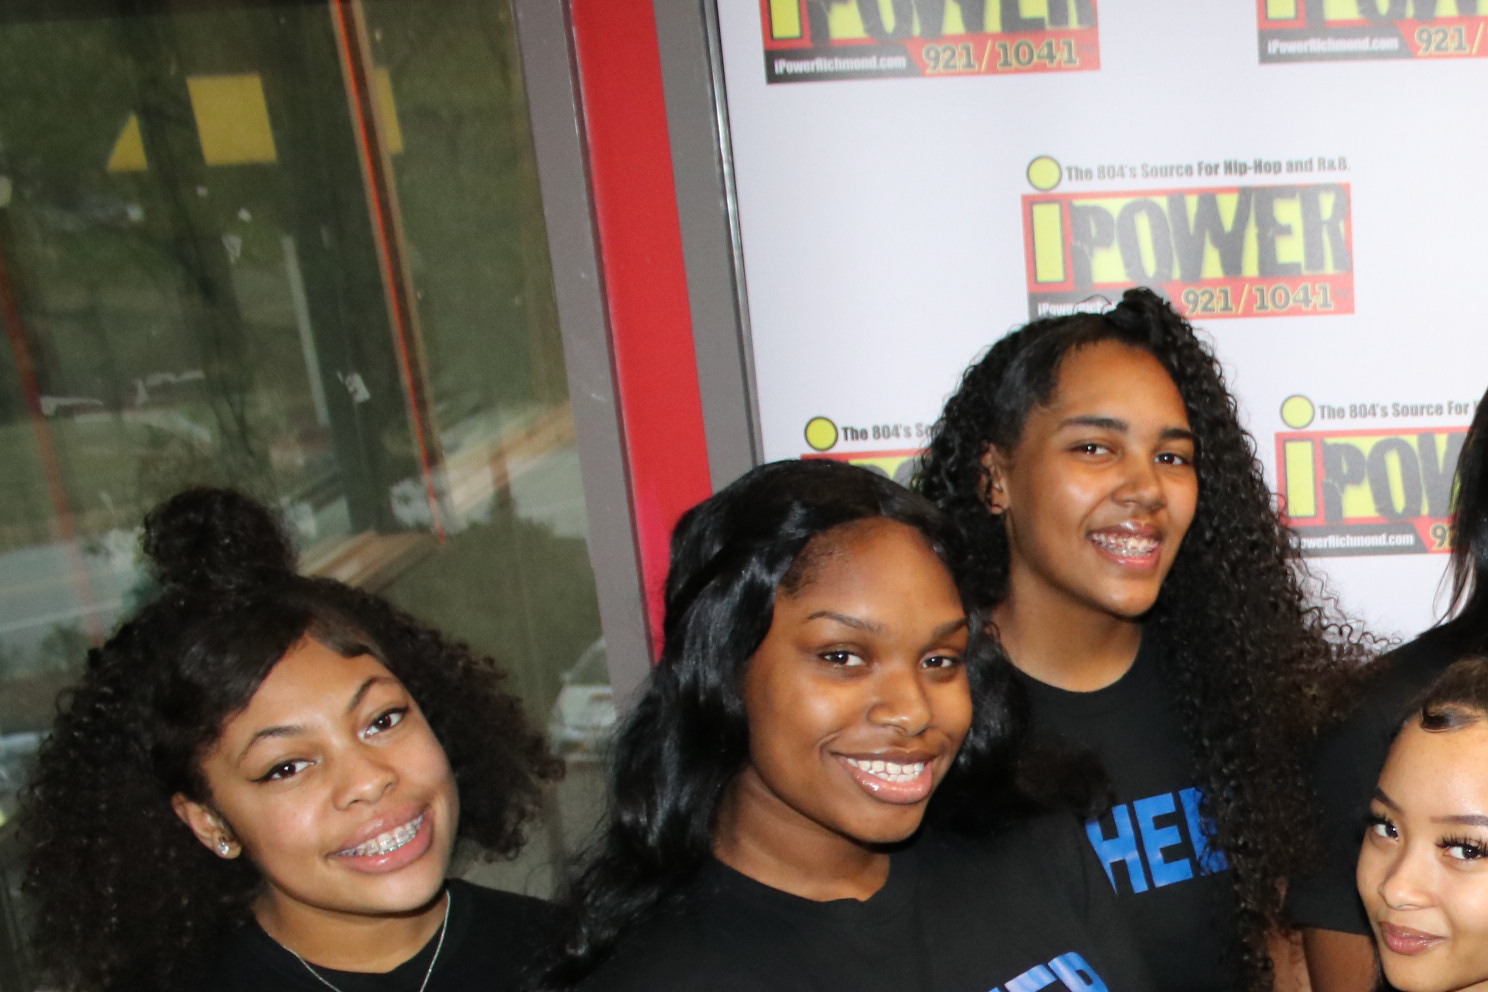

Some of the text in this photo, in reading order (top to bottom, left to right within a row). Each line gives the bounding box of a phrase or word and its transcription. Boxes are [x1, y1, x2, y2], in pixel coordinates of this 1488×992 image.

[774, 56, 906, 75] iPowerRichmond.com
[1066, 165, 1093, 181] The
[1097, 163, 1137, 180] 804's
[1141, 162, 1194, 179] Source
[1197, 160, 1219, 176] For
[1223, 158, 1282, 177] Hip-Hop
[1285, 158, 1313, 174] and
[1318, 404, 1345, 419] The
[1349, 402, 1388, 418] 804's
[1391, 401, 1444, 417] Source
[1447, 400, 1470, 415] For
[842, 427, 869, 441] The
[871, 424, 913, 440] 804's
